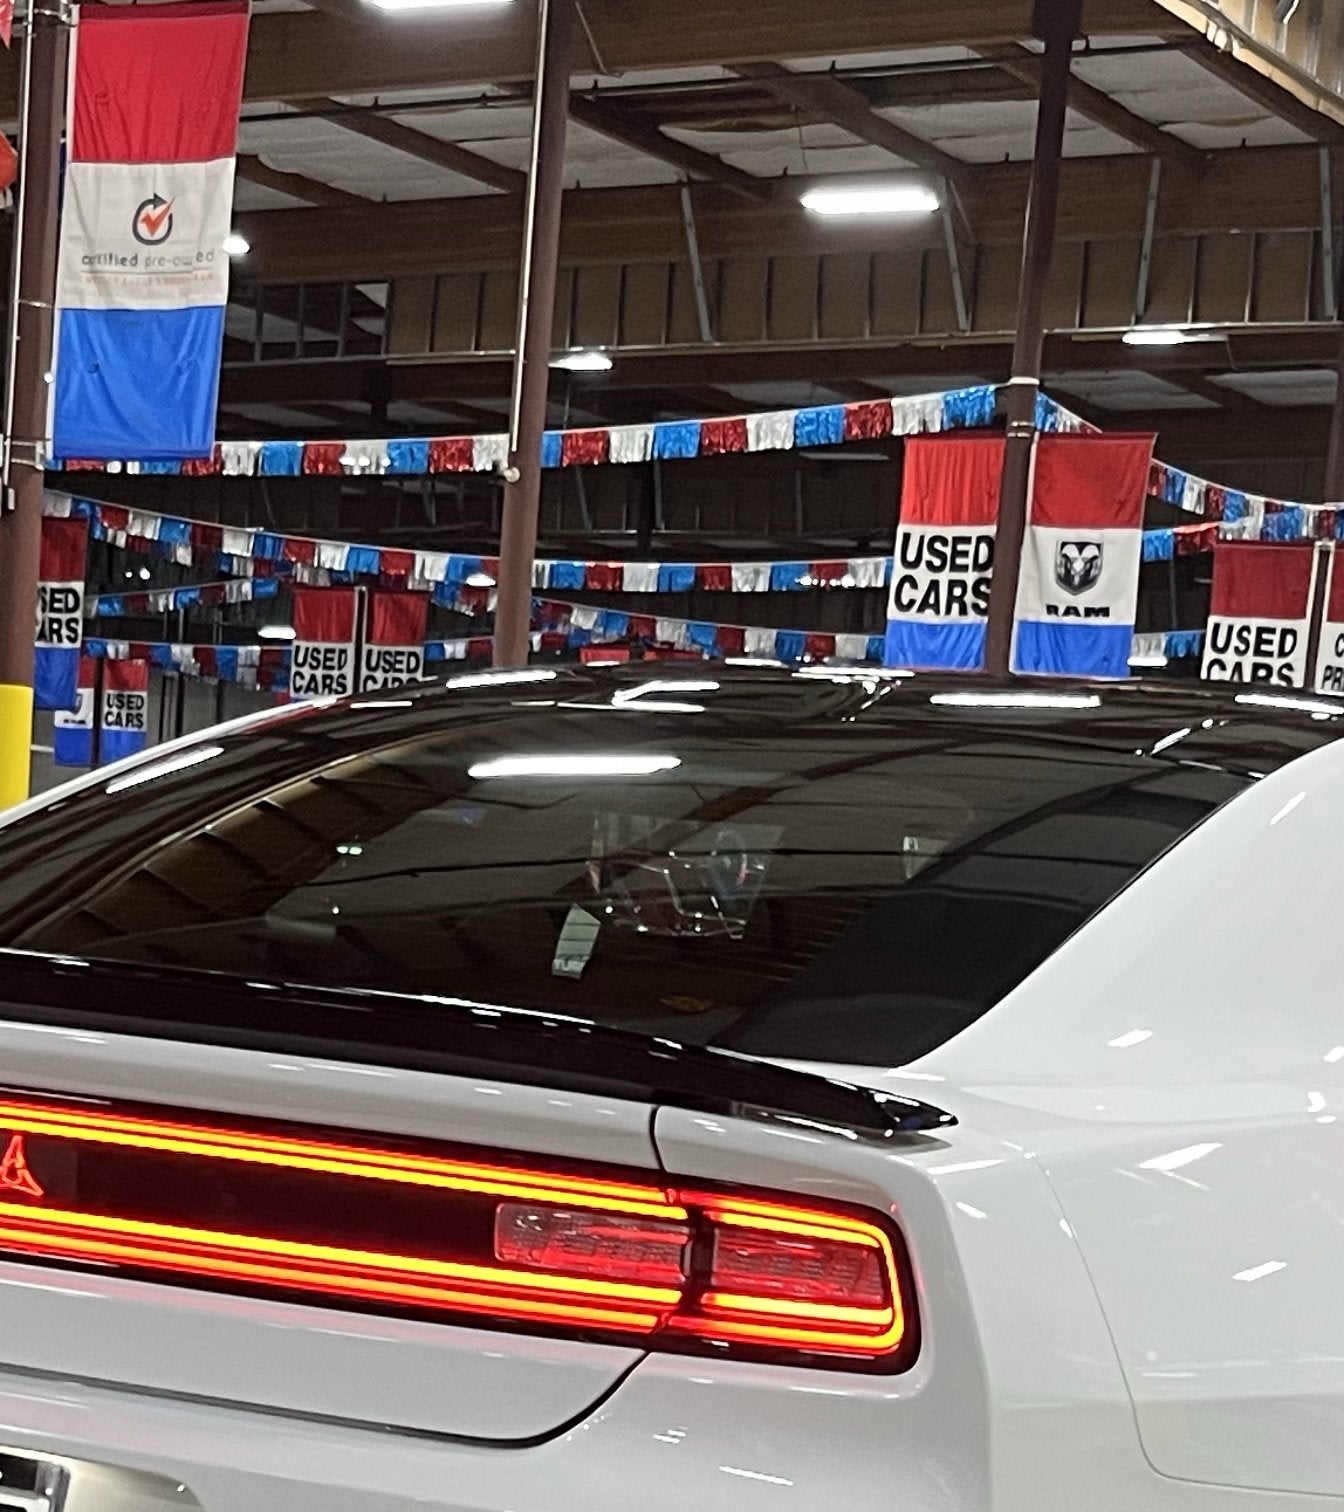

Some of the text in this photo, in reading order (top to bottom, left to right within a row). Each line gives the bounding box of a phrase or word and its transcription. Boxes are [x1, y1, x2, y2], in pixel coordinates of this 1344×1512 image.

[900, 532, 994, 573] USED
[894, 574, 991, 616] CARS
[1045, 604, 1110, 617] RAM
[1210, 622, 1298, 659] USED
[294, 645, 348, 671] USED
[365, 649, 420, 674] USED
[292, 671, 348, 695] CARS
[106, 693, 144, 711] USED
[104, 711, 144, 729] CARS
